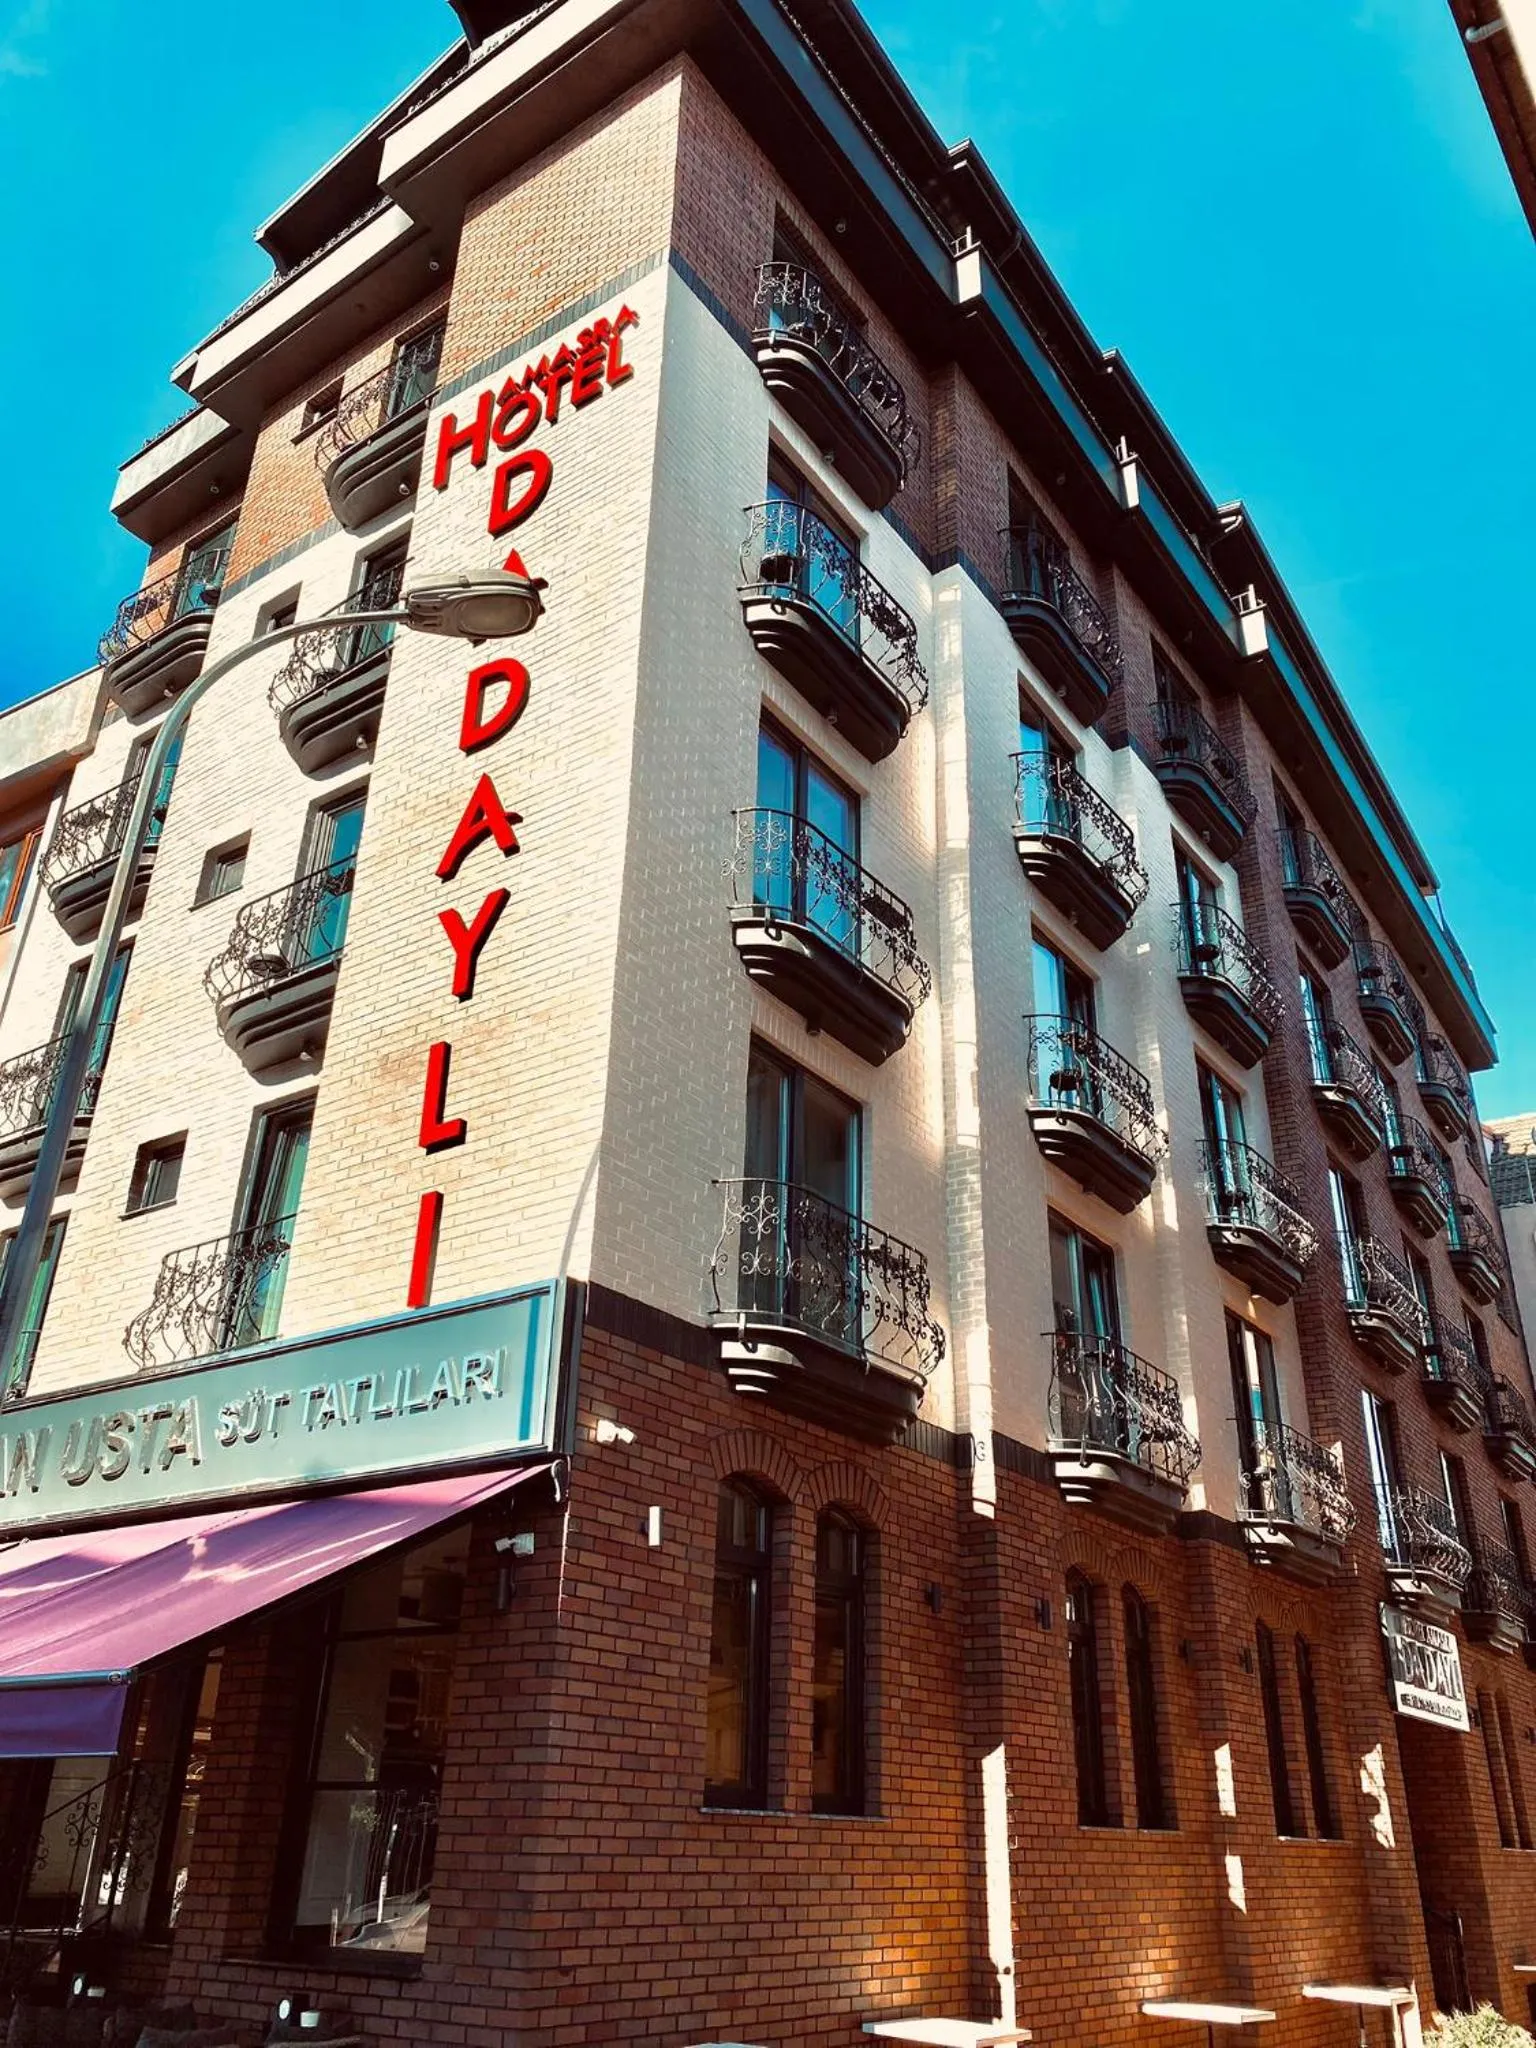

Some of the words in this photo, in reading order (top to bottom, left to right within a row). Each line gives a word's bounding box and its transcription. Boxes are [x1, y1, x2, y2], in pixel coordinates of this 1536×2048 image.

[433, 334, 635, 493] HOTEL
[496, 303, 640, 406] AMASRA
[60, 1395, 202, 1487] USTA
[214, 1384, 293, 1448] SÜT
[300, 1346, 508, 1433] TATLILARI
